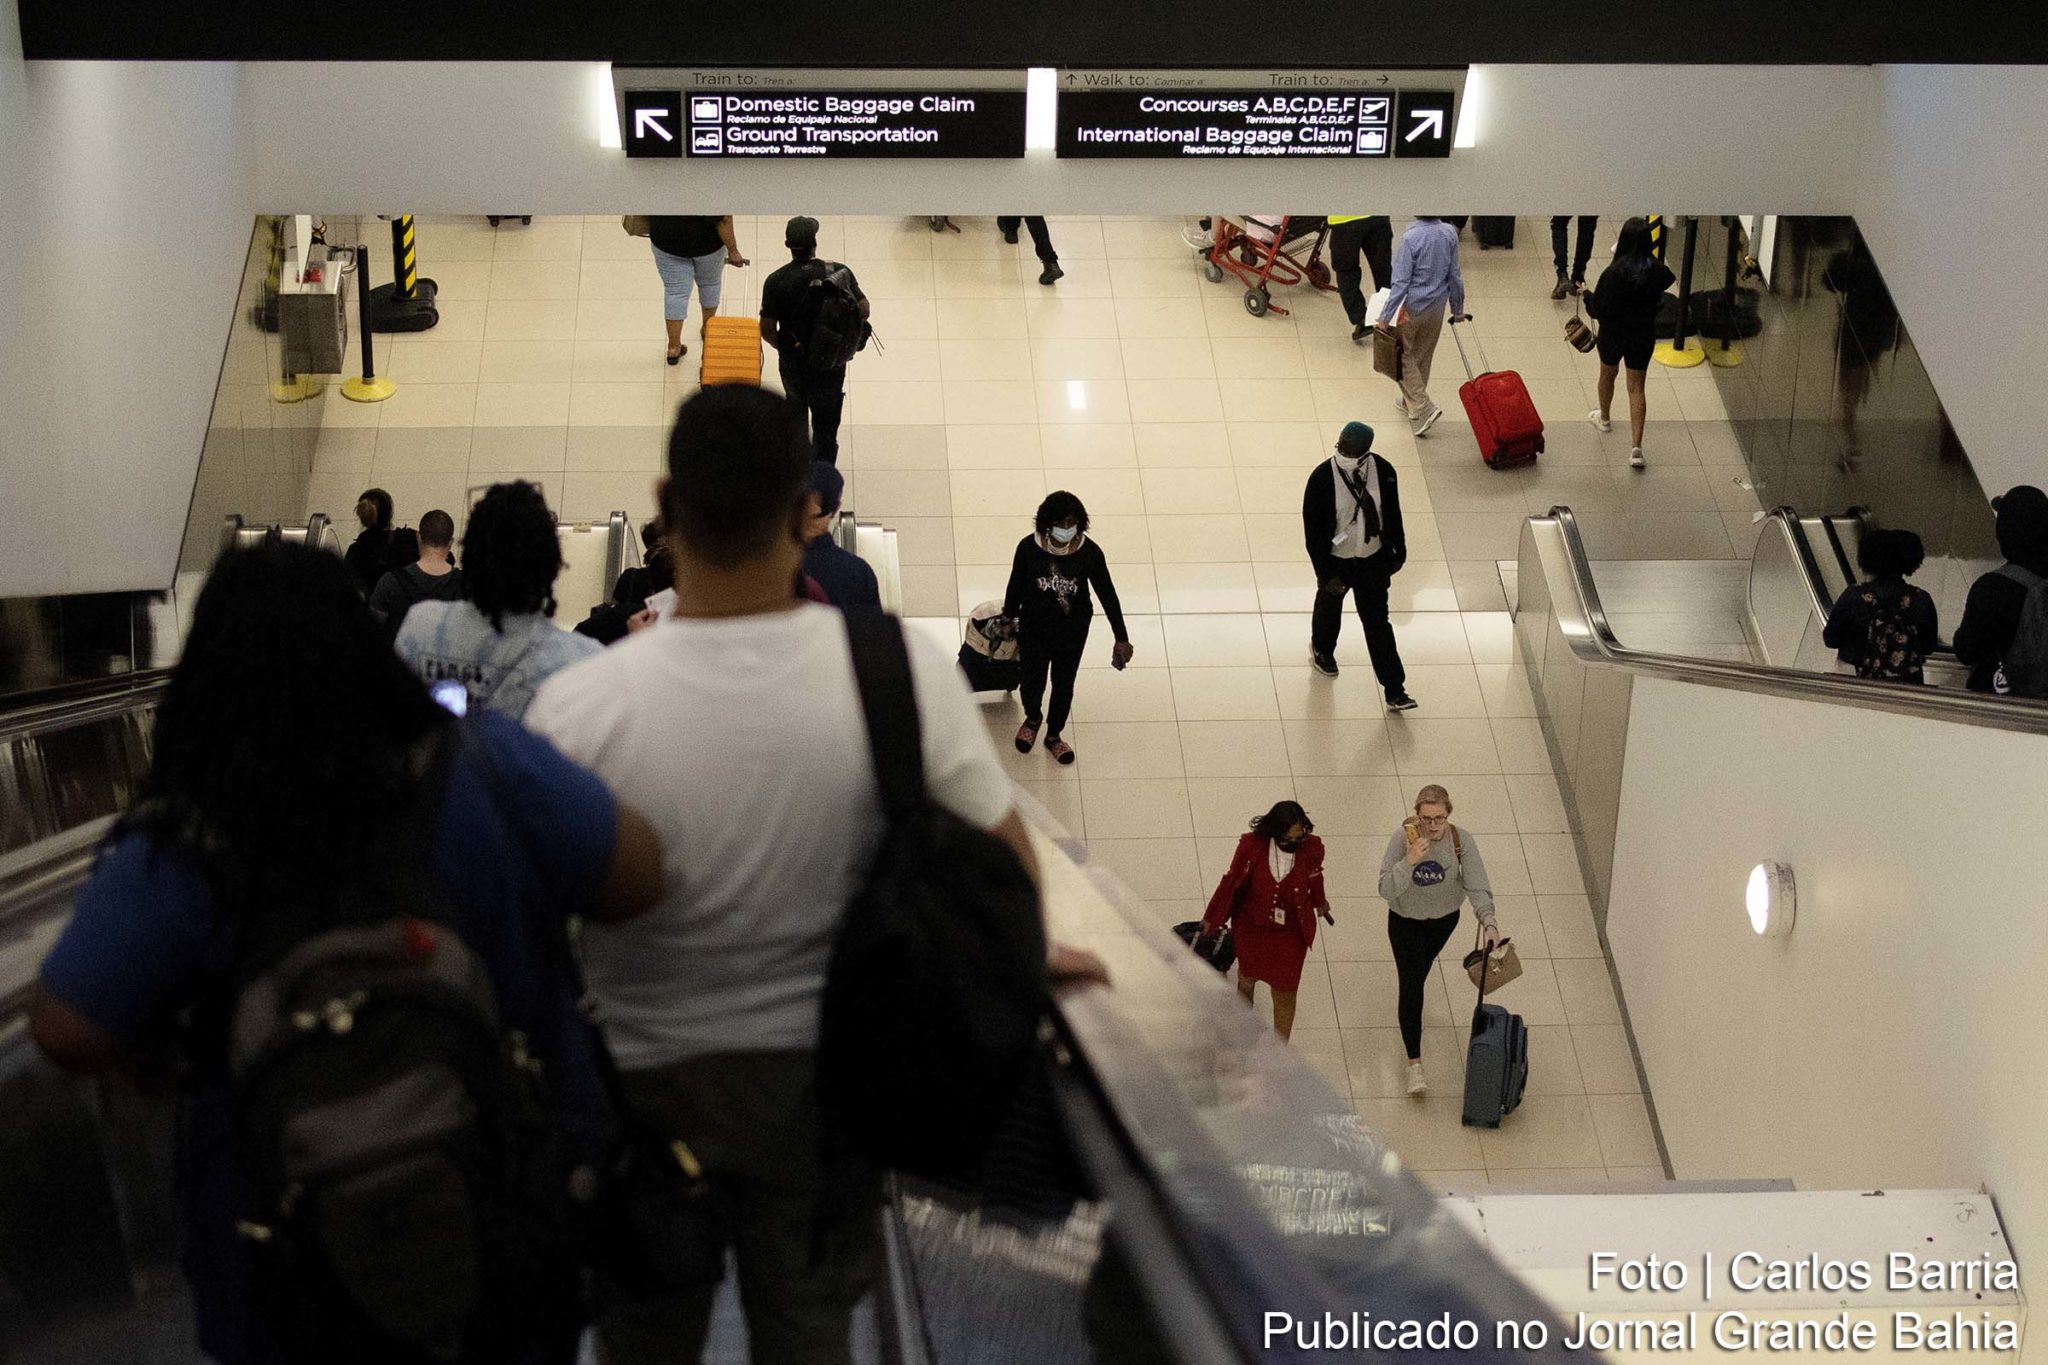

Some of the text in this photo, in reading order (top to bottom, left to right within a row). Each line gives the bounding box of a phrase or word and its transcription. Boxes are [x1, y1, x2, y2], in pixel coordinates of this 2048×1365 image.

[692, 73, 731, 85] Train
[738, 74, 758, 85] to:
[1085, 74, 1123, 86] Walk
[1129, 75, 1149, 86] to:
[1270, 74, 1308, 86] Train
[1313, 75, 1333, 86] to:
[726, 96, 976, 114] Domestic Baggage Claim
[1139, 97, 1356, 114] Concourses A,B,C,D,E,F
[726, 115, 878, 126] Reclamo de Equipaje Nacional
[1245, 115, 1354, 126] Terminales A,B,C,D,E,F
[726, 126, 939, 144] Ground Transportation
[1077, 127, 1353, 145] International Baggage Claim
[727, 145, 827, 155] Transporte Terrestre
[1183, 145, 1352, 155] Reclamo de Equipaje Internacional
[1414, 871, 1443, 880] NASA
